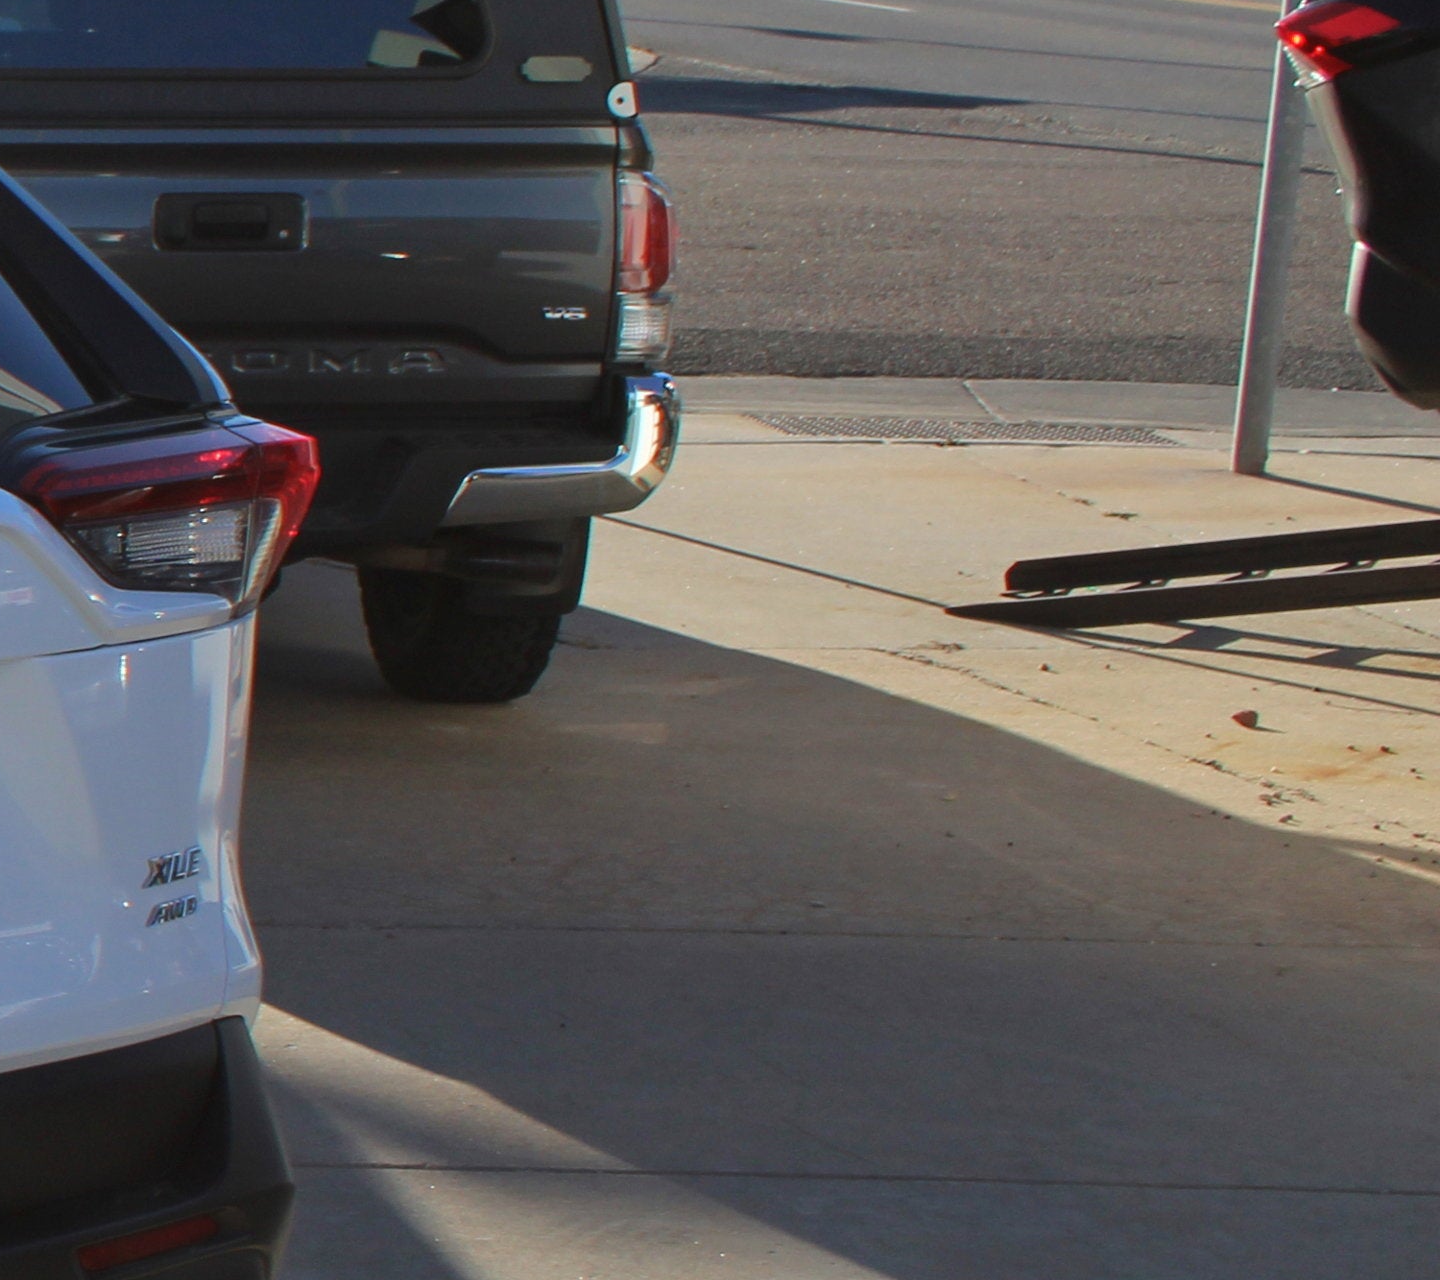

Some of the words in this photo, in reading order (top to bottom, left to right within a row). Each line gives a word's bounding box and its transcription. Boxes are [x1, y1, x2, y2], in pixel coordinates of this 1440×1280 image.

[229, 347, 447, 375] OMA
[141, 845, 201, 890] XLE
[145, 894, 198, 927] AWD
